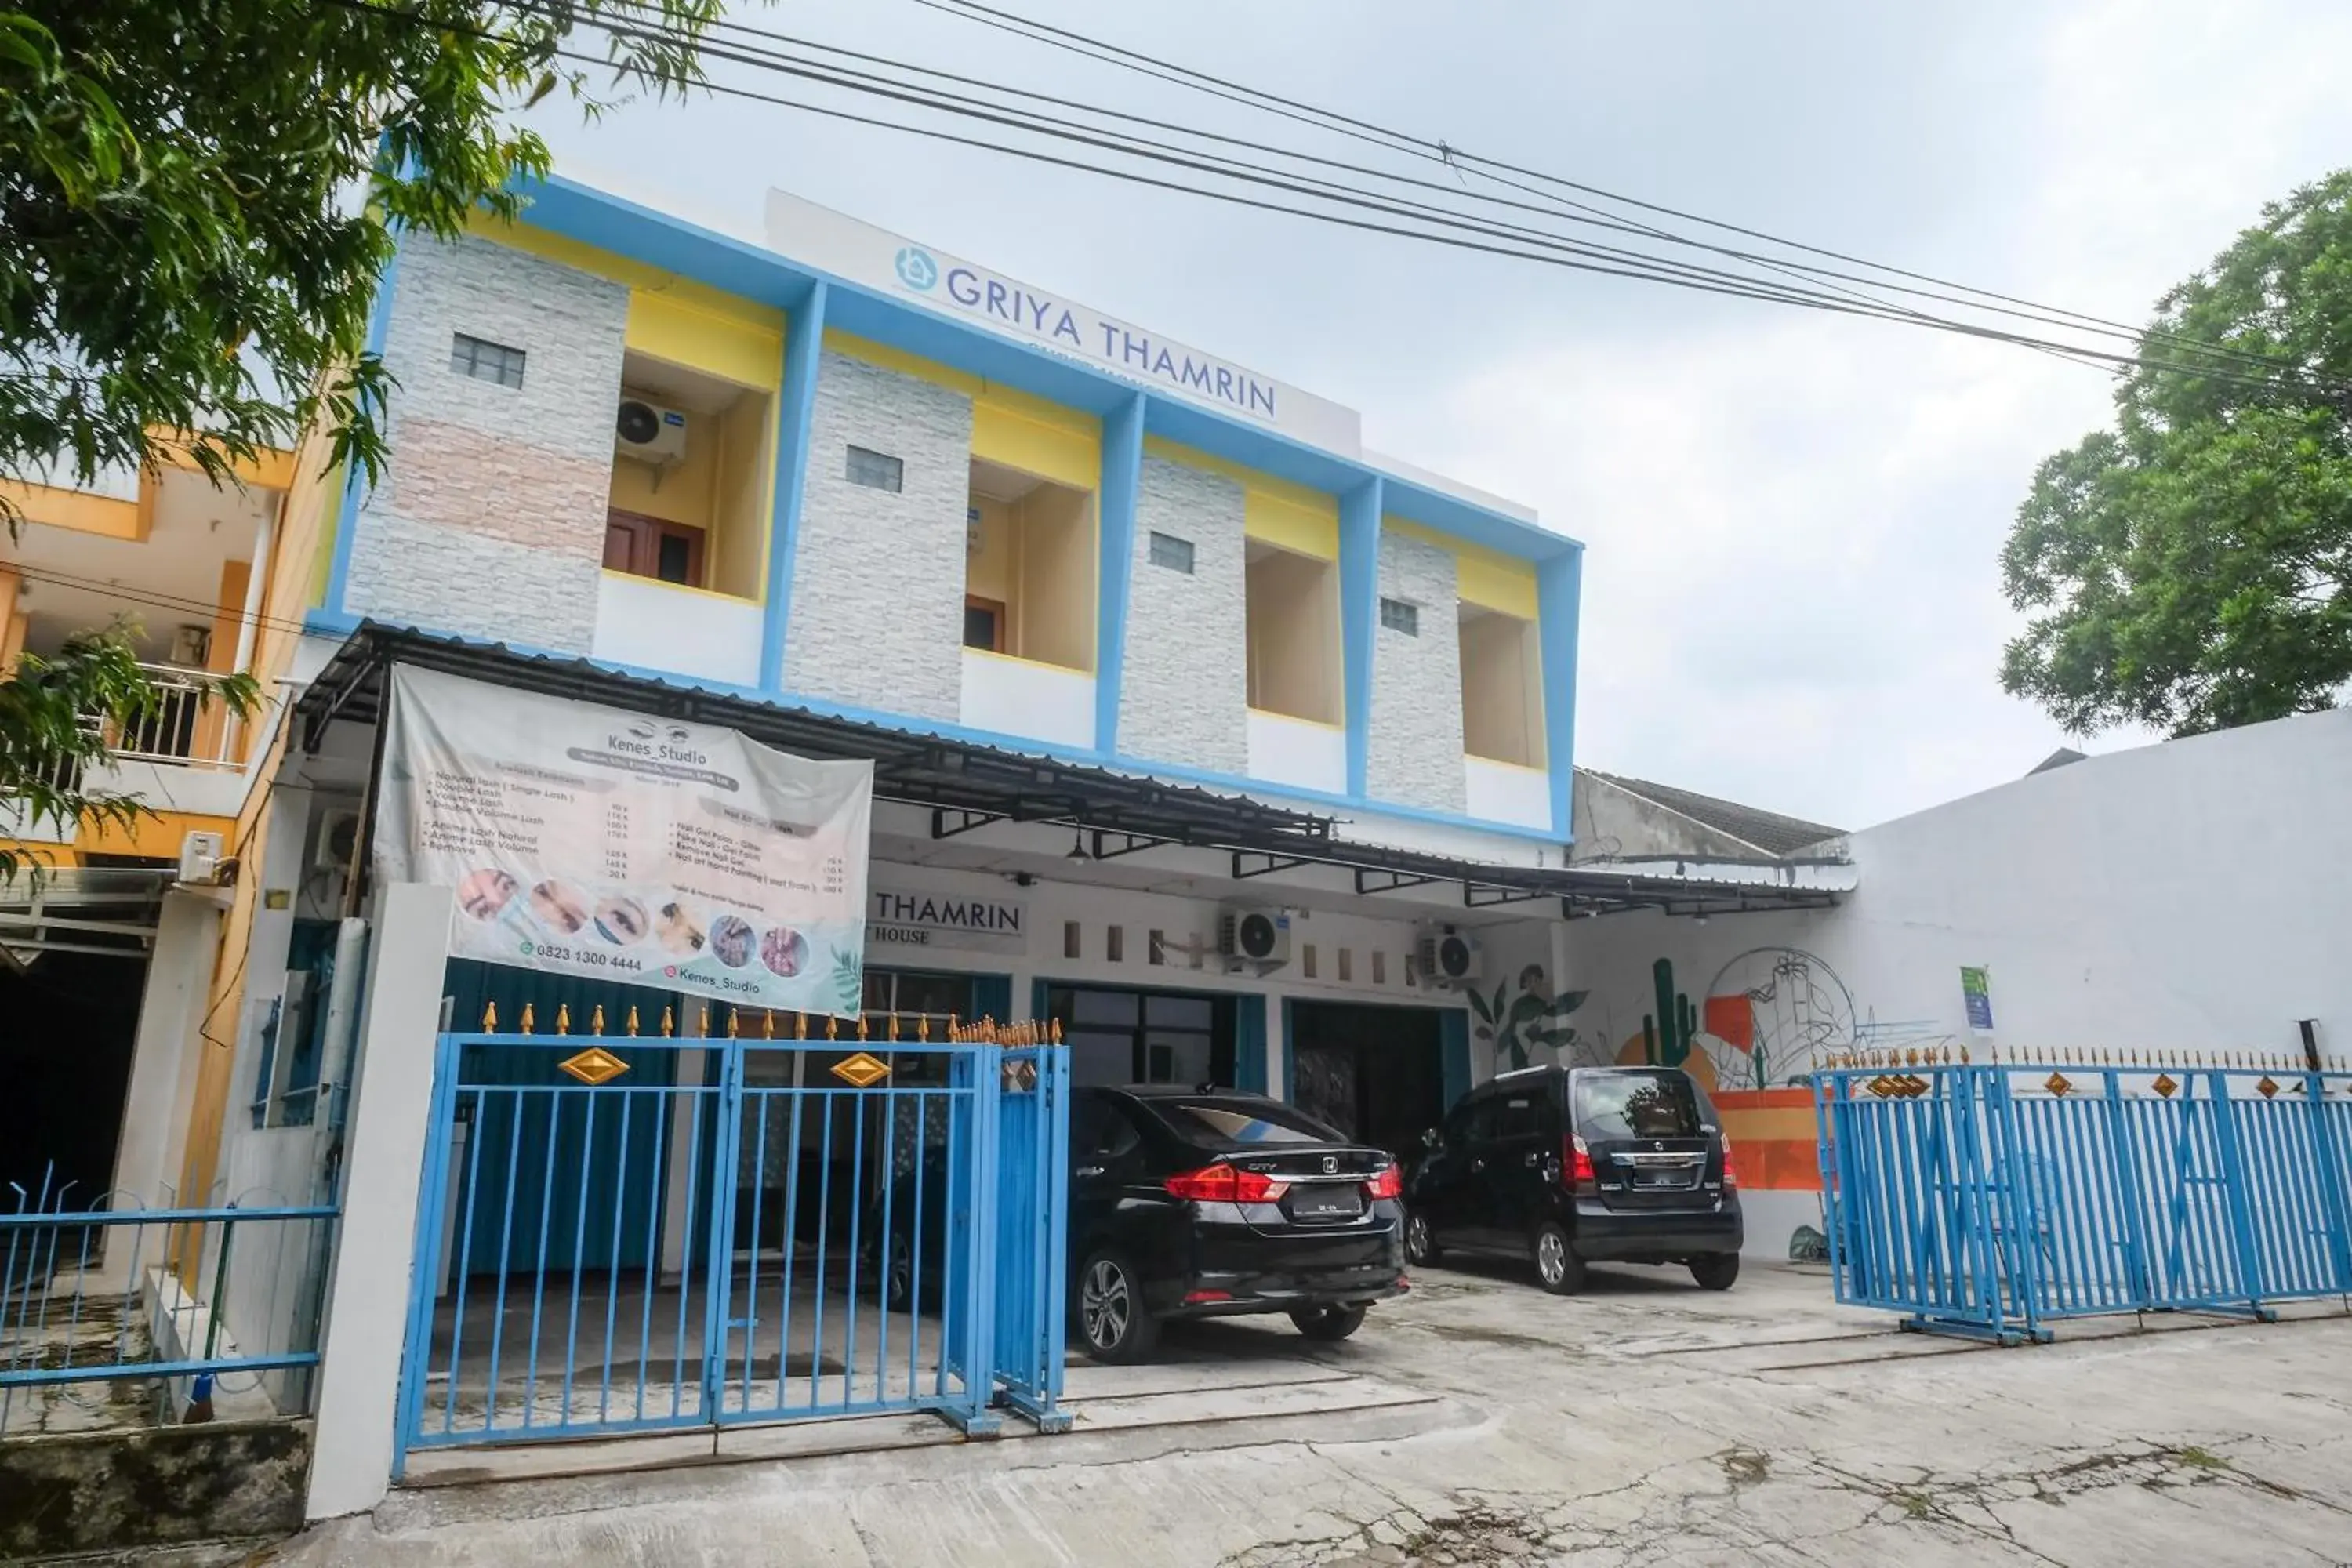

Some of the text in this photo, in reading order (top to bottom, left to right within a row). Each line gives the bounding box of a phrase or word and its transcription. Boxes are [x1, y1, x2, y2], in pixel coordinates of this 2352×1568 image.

[947, 268, 1080, 347] GRIYA
[1099, 321, 1275, 418] THAMRIN
[608, 734, 706, 765] Kenes_Studio
[498, 829, 538, 844] Natural
[499, 840, 540, 854] Volume
[876, 892, 1019, 931] THAMRIN
[875, 927, 930, 945] HOUSE
[537, 944, 641, 971] 0823 1300 4444
[679, 967, 760, 993] Kenes_Studio
